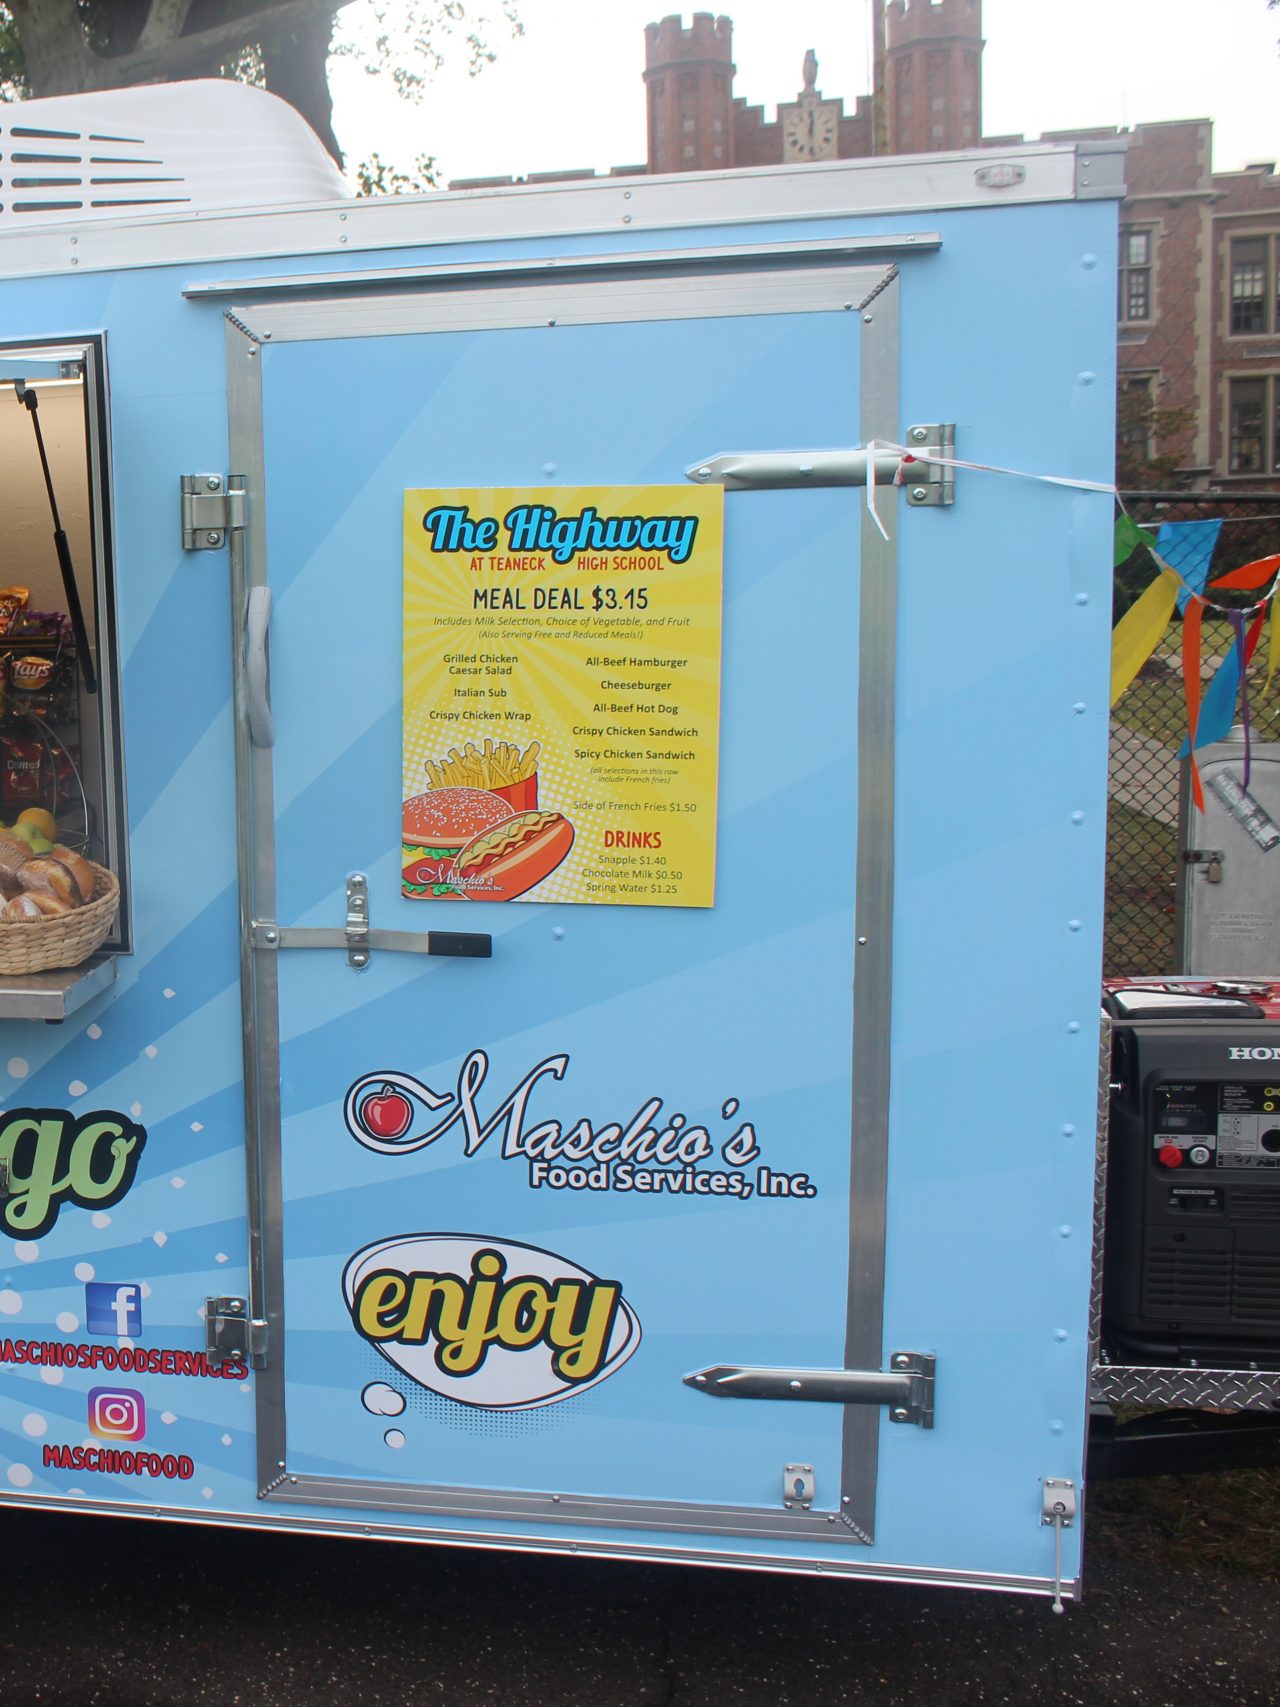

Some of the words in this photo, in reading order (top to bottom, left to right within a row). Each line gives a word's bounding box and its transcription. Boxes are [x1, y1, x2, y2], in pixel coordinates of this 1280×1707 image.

[423, 505, 499, 552] The
[504, 505, 700, 565] Highway
[470, 557, 484, 571] AT
[488, 557, 546, 571] TEANECK
[577, 556, 611, 571] HIGH
[613, 557, 665, 571] SCHOOL
[473, 588, 526, 610] MEAL
[533, 588, 585, 610] DEAL
[592, 585, 649, 612] $3.15
[433, 617, 472, 627] Includes
[475, 617, 495, 627] Milk
[497, 617, 542, 628] Selection,
[545, 616, 578, 627] Choice
[579, 616, 591, 628] of
[593, 616, 642, 628] Vegetable,
[646, 616, 666, 627] and
[667, 616, 690, 627] Fruit
[478, 630, 499, 640] (Also
[501, 630, 532, 641] Serving
[534, 630, 552, 640] Free
[554, 630, 570, 640] and
[572, 630, 609, 640] Reduced
[611, 630, 643, 641] Meals!)
[443, 654, 477, 664] Grilled
[479, 654, 518, 664] Chicken
[586, 657, 627, 668] All-Beef
[629, 658, 687, 669] Hamburger
[13, 662, 50, 679] Lay's
[449, 666, 483, 676] Caesar
[486, 666, 512, 676] Salad
[600, 680, 672, 692] Cheeseburger
[454, 688, 485, 698] Italian
[488, 688, 507, 698] Sub
[593, 704, 634, 714] All-Beef
[637, 704, 655, 714] Hot
[658, 704, 679, 715] Dog
[429, 711, 460, 721] Crispy
[463, 711, 501, 721] Chicken
[504, 711, 531, 721] Wrap
[572, 727, 604, 737] Crispy
[606, 727, 646, 737] Chicken
[648, 727, 698, 738] Sandwich
[574, 749, 601, 760] Spicy
[604, 749, 643, 760] Chicken
[645, 750, 695, 761] Sandwich
[604, 767, 639, 775] selections
[625, 776, 650, 784] French
[573, 801, 593, 810] Side
[596, 801, 607, 810] of
[609, 801, 641, 811] French
[644, 802, 667, 812] Fries
[670, 802, 697, 813] $1.50
[604, 830, 662, 849] DRINKS
[598, 856, 637, 866] Snapple
[639, 856, 667, 866] $1.40
[416, 863, 494, 885] Maschio's
[582, 869, 630, 879] Chocolate
[632, 869, 652, 879] Milk
[655, 870, 683, 881] $0.50
[585, 883, 615, 894] Spring
[618, 883, 648, 893] Water
[650, 884, 678, 895] $1.25
[344, 1049, 760, 1165] Maschio's
[530, 1161, 608, 1191] Food
[613, 1164, 753, 1199] Services,
[757, 1168, 817, 1198] Inc.
[355, 1250, 620, 1382] enjoy
[43, 1445, 194, 1479] MASCHIOFOOD
